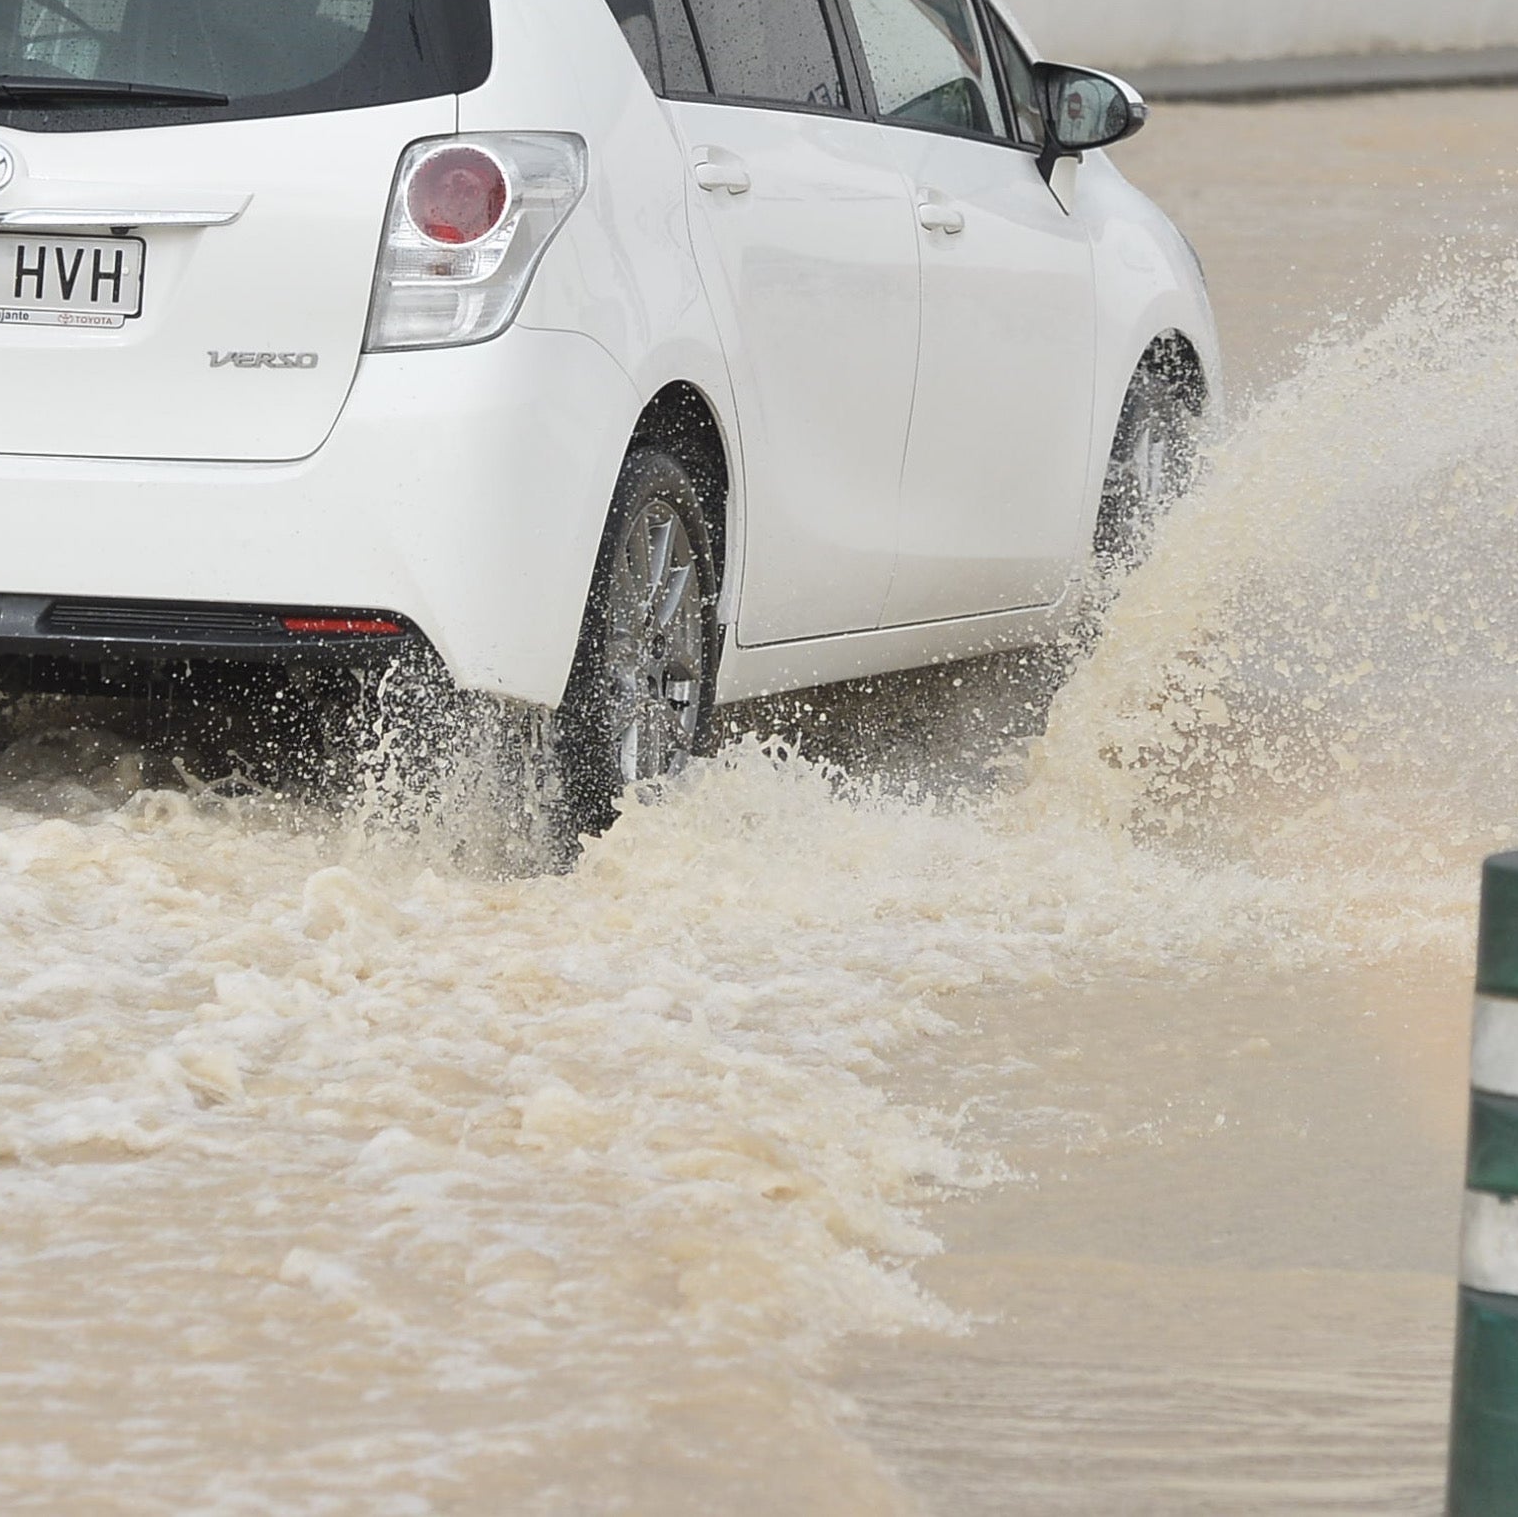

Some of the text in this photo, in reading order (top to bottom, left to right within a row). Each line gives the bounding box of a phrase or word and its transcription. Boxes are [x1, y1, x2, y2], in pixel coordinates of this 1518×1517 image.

[14, 245, 123, 304] HVH
[75, 316, 113, 325] TOYOTA
[207, 351, 319, 369] VERSO
